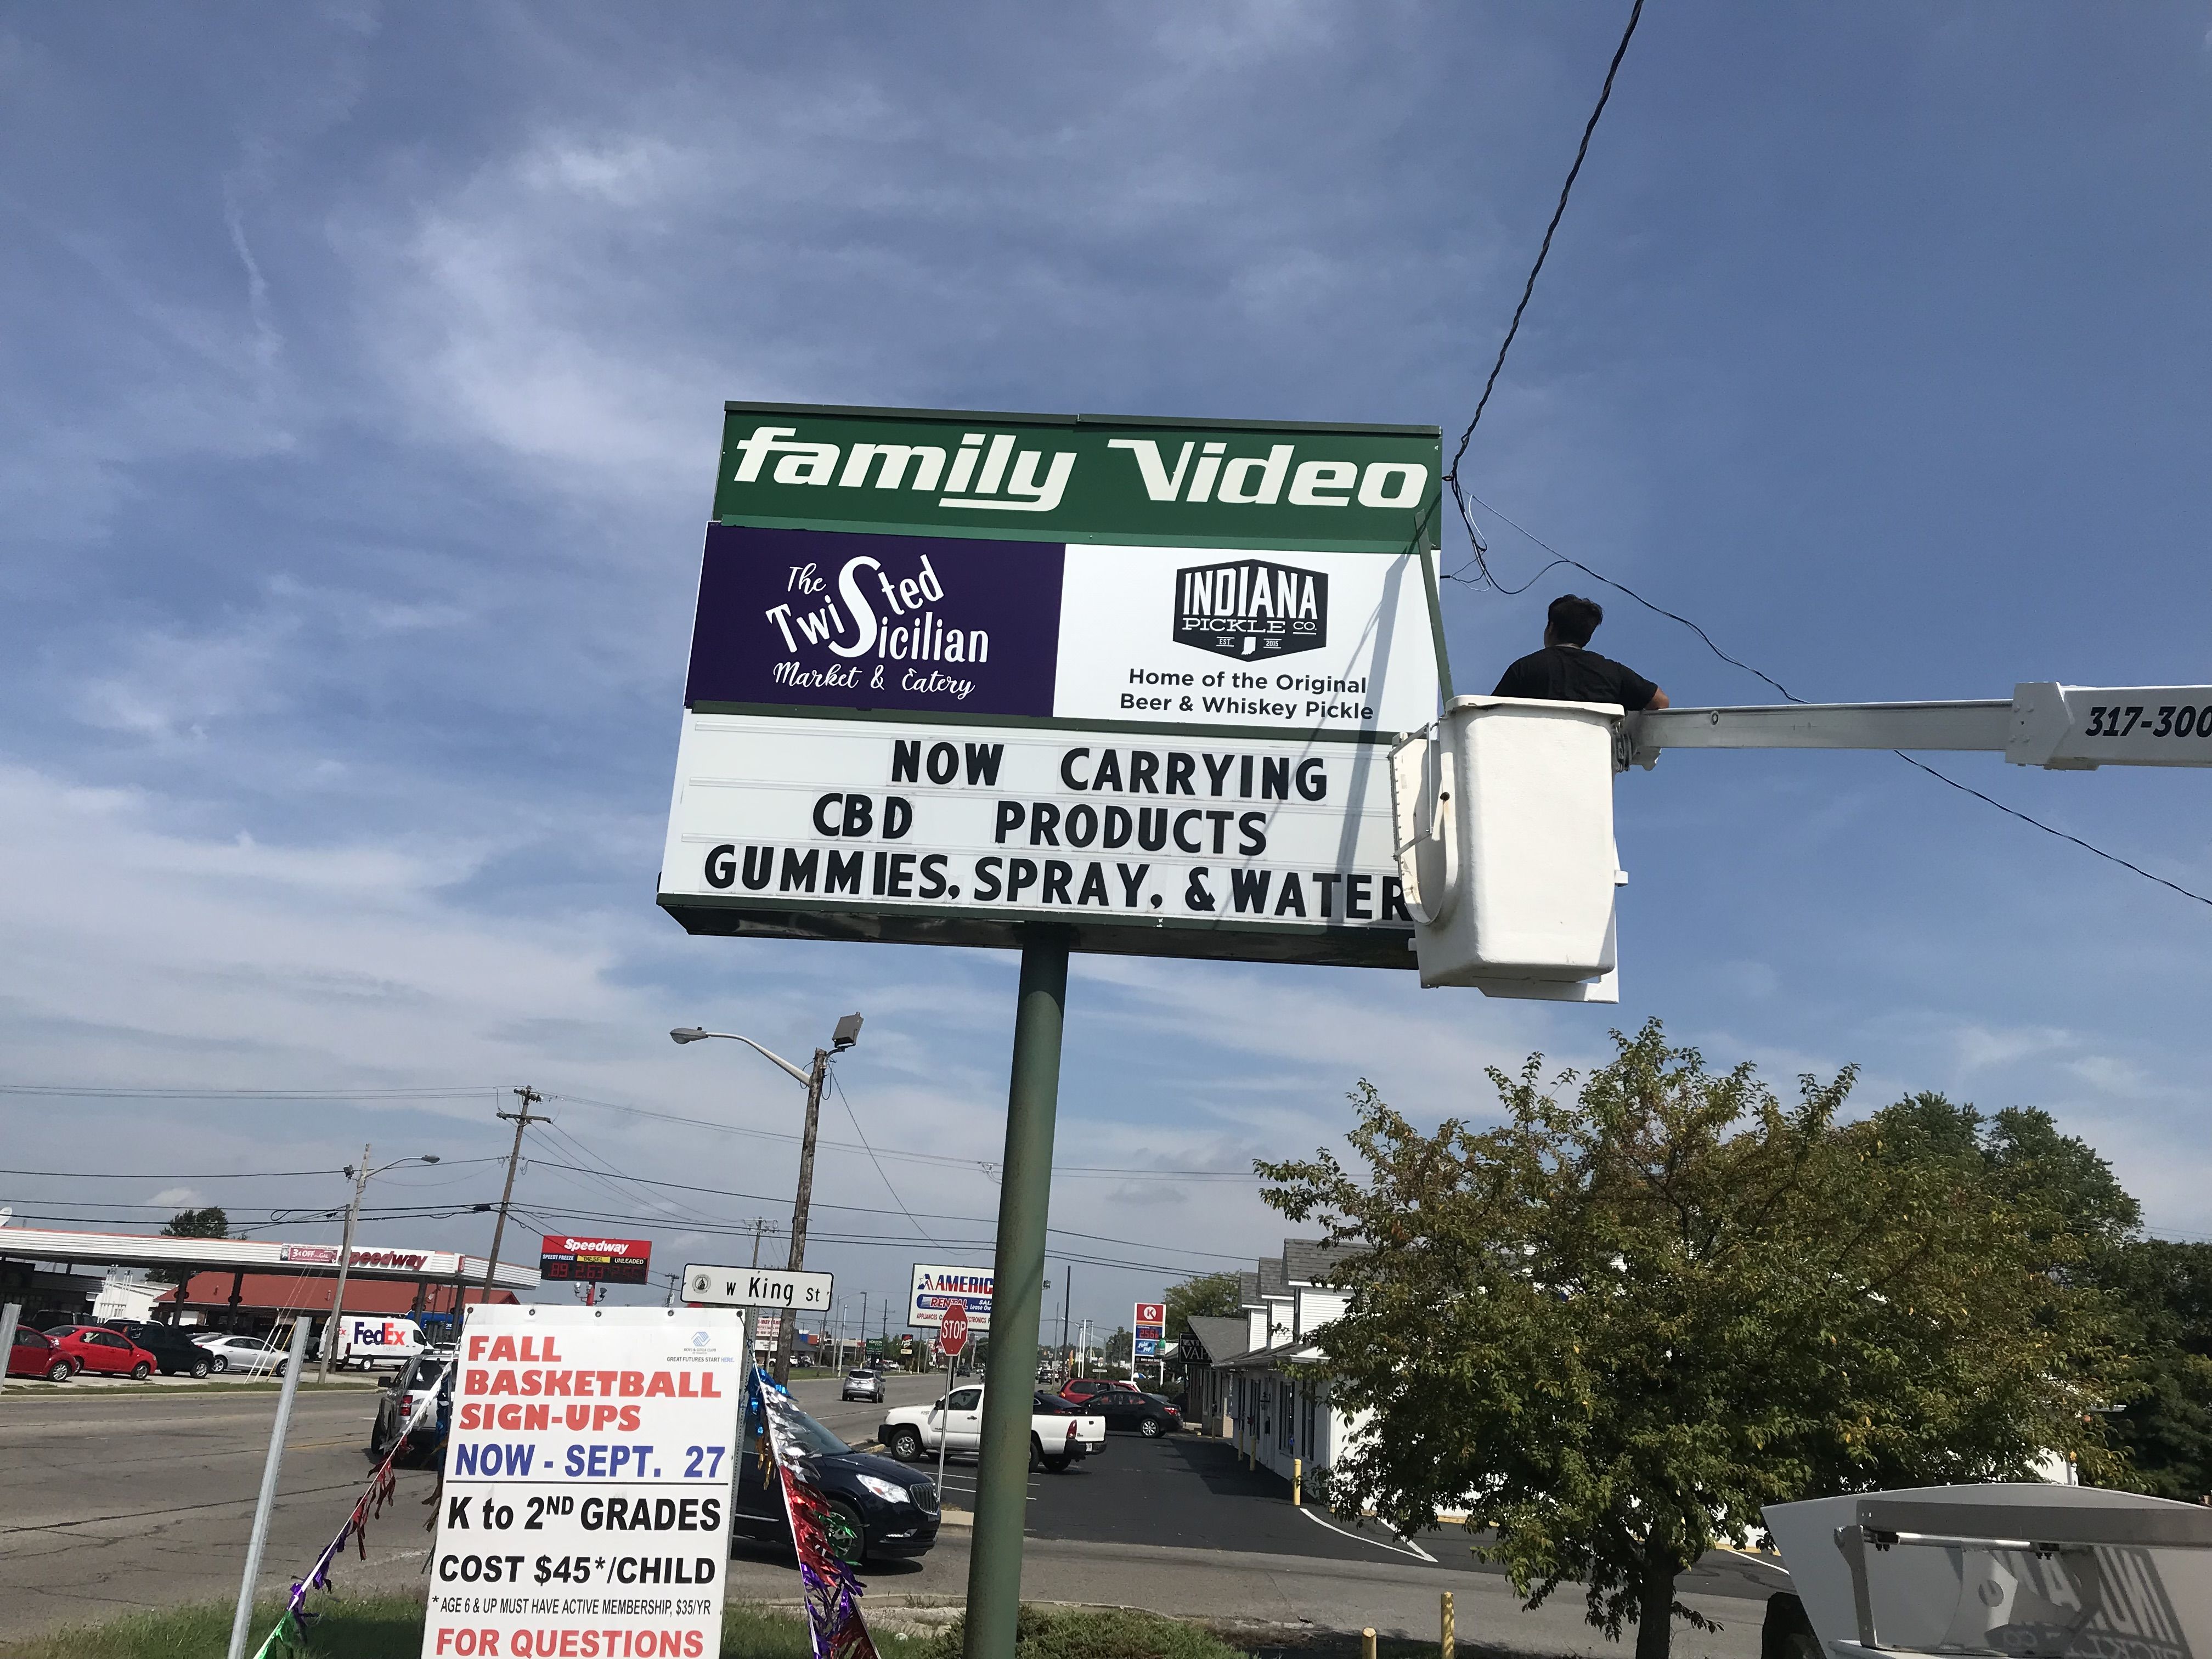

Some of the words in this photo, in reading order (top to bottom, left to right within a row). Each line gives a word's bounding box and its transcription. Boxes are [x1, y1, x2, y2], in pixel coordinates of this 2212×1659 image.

[734, 426, 1077, 511] family
[1108, 439, 1427, 509] Video
[787, 562, 827, 595] The
[1183, 566, 1318, 619] INDIANA
[1182, 617, 1286, 634] PICKLE
[1266, 640, 1279, 648] 2015
[772, 661, 862, 688] Market
[870, 664, 885, 691] &
[901, 667, 976, 701] Eatery
[1129, 668, 1194, 686] Home
[1201, 671, 1225, 688] of
[1232, 672, 1268, 689] the
[1276, 674, 1367, 695] Original
[1120, 693, 1172, 711] Beer
[1179, 695, 1194, 712] &
[1202, 696, 1297, 719] Whiskey
[1306, 701, 1374, 720] Pickle
[891, 740, 1005, 787] NOW
[1060, 747, 1327, 802] CARRYING
[812, 792, 913, 839] CBD
[995, 800, 1267, 856] PRODUCTS
[704, 844, 961, 900] GUMMIES,
[974, 856, 1163, 910] SPRAY,
[1185, 866, 1216, 912] &
[564, 1238, 629, 1255] Speedway
[726, 1282, 736, 1296] W
[748, 1277, 794, 1307] King
[805, 1288, 820, 1302] St
[1147, 1309, 1154, 1318] K
[354, 1321, 405, 1346] FedEx
[942, 1319, 967, 1339] STOP
[468, 1336, 562, 1362] FALL
[464, 1370, 721, 1398] BASKETBALL
[459, 1403, 641, 1431] SIGN-UPS
[455, 1443, 535, 1476] NOW
[565, 1445, 661, 1478] SEPT.
[684, 1446, 725, 1478] 27
[448, 1497, 472, 1530] K
[482, 1498, 514, 1530] to
[580, 1498, 721, 1531] GRADES
[439, 1554, 524, 1583] COST
[441, 1597, 461, 1613] AGE
[464, 1597, 470, 1613] 6
[472, 1598, 480, 1613] &
[483, 1598, 496, 1614] UP
[500, 1598, 529, 1614] MUST
[532, 1598, 558, 1615] HAVE
[562, 1599, 599, 1615] ACTIVE
[602, 1599, 673, 1617] MEMBERSHIP,
[676, 1599, 711, 1617] $35/YR
[436, 1628, 500, 1657] FOR
[510, 1629, 703, 1659] QUESTIONS
